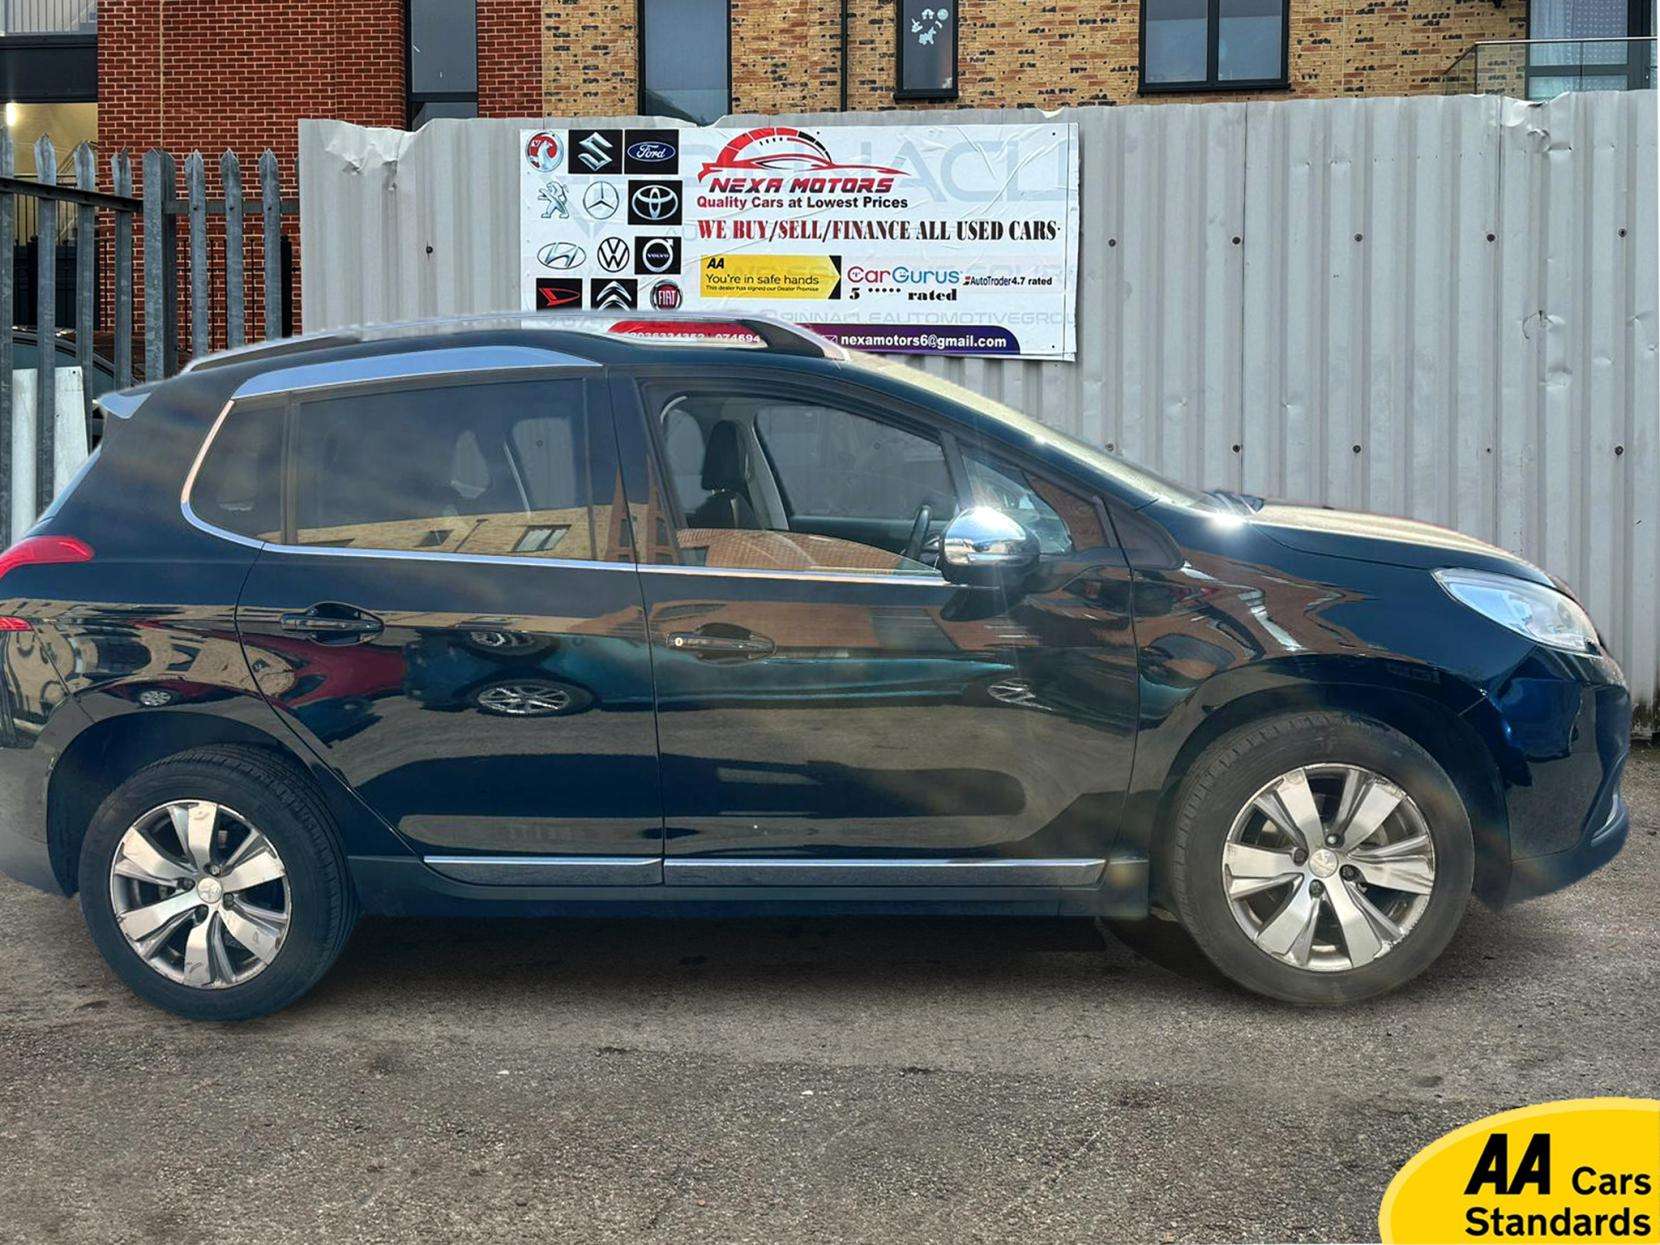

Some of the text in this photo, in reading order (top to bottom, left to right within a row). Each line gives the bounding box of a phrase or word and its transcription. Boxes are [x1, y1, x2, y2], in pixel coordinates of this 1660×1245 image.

[636, 143, 666, 159] Ford
[708, 177, 894, 194] NEXA MOTORS
[697, 196, 909, 211] Quality Cars at Lowest Prices
[697, 219, 727, 240] WE
[916, 220, 951, 241] ALL
[957, 220, 1004, 241] USED
[1008, 220, 1057, 241] CARS
[706, 257, 725, 269] AA
[706, 273, 819, 286] You're in safe hands
[847, 265, 960, 284] CarGurus
[1027, 276, 1053, 286] rated
[658, 290, 677, 306] FIAT
[849, 287, 958, 301] 5 rated
[840, 333, 1007, 349] nexamotors6@gmail.com
